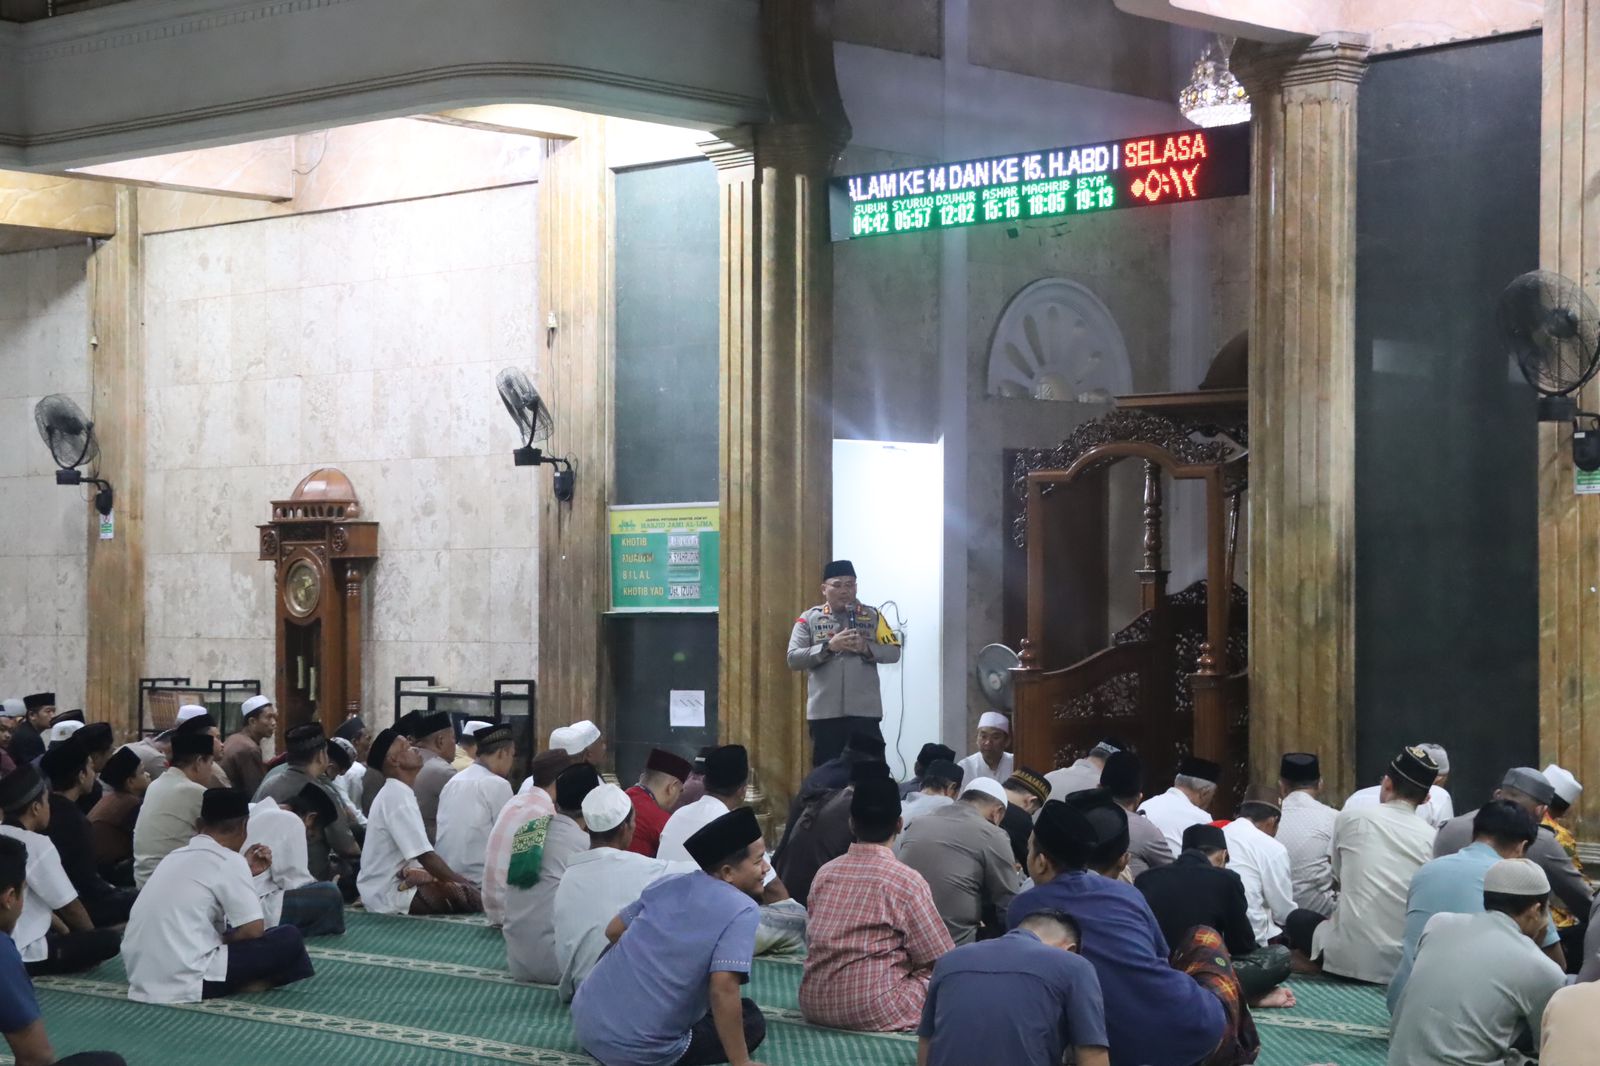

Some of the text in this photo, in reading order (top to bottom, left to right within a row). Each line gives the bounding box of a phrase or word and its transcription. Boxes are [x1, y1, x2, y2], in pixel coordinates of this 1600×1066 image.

[1125, 133, 1207, 168] SELASA
[900, 170, 924, 195] KE
[928, 167, 945, 192] 14
[950, 162, 988, 190] DAN
[992, 158, 1018, 184] KE
[853, 213, 889, 235] 04:42
[894, 207, 931, 230] 05:57
[939, 203, 975, 225] 12:02
[983, 197, 1019, 220] 15:15
[1074, 185, 1113, 211] 19:13
[855, 202, 888, 215] SUBUH
[892, 197, 933, 212] SYURUQ
[935, 191, 976, 206] DZUHUR
[982, 186, 1018, 200] ASHAR
[1022, 180, 1070, 196] MAGHRIB
[622, 537, 647, 546] KHOTIB
[624, 587, 648, 596] KHOTIB
